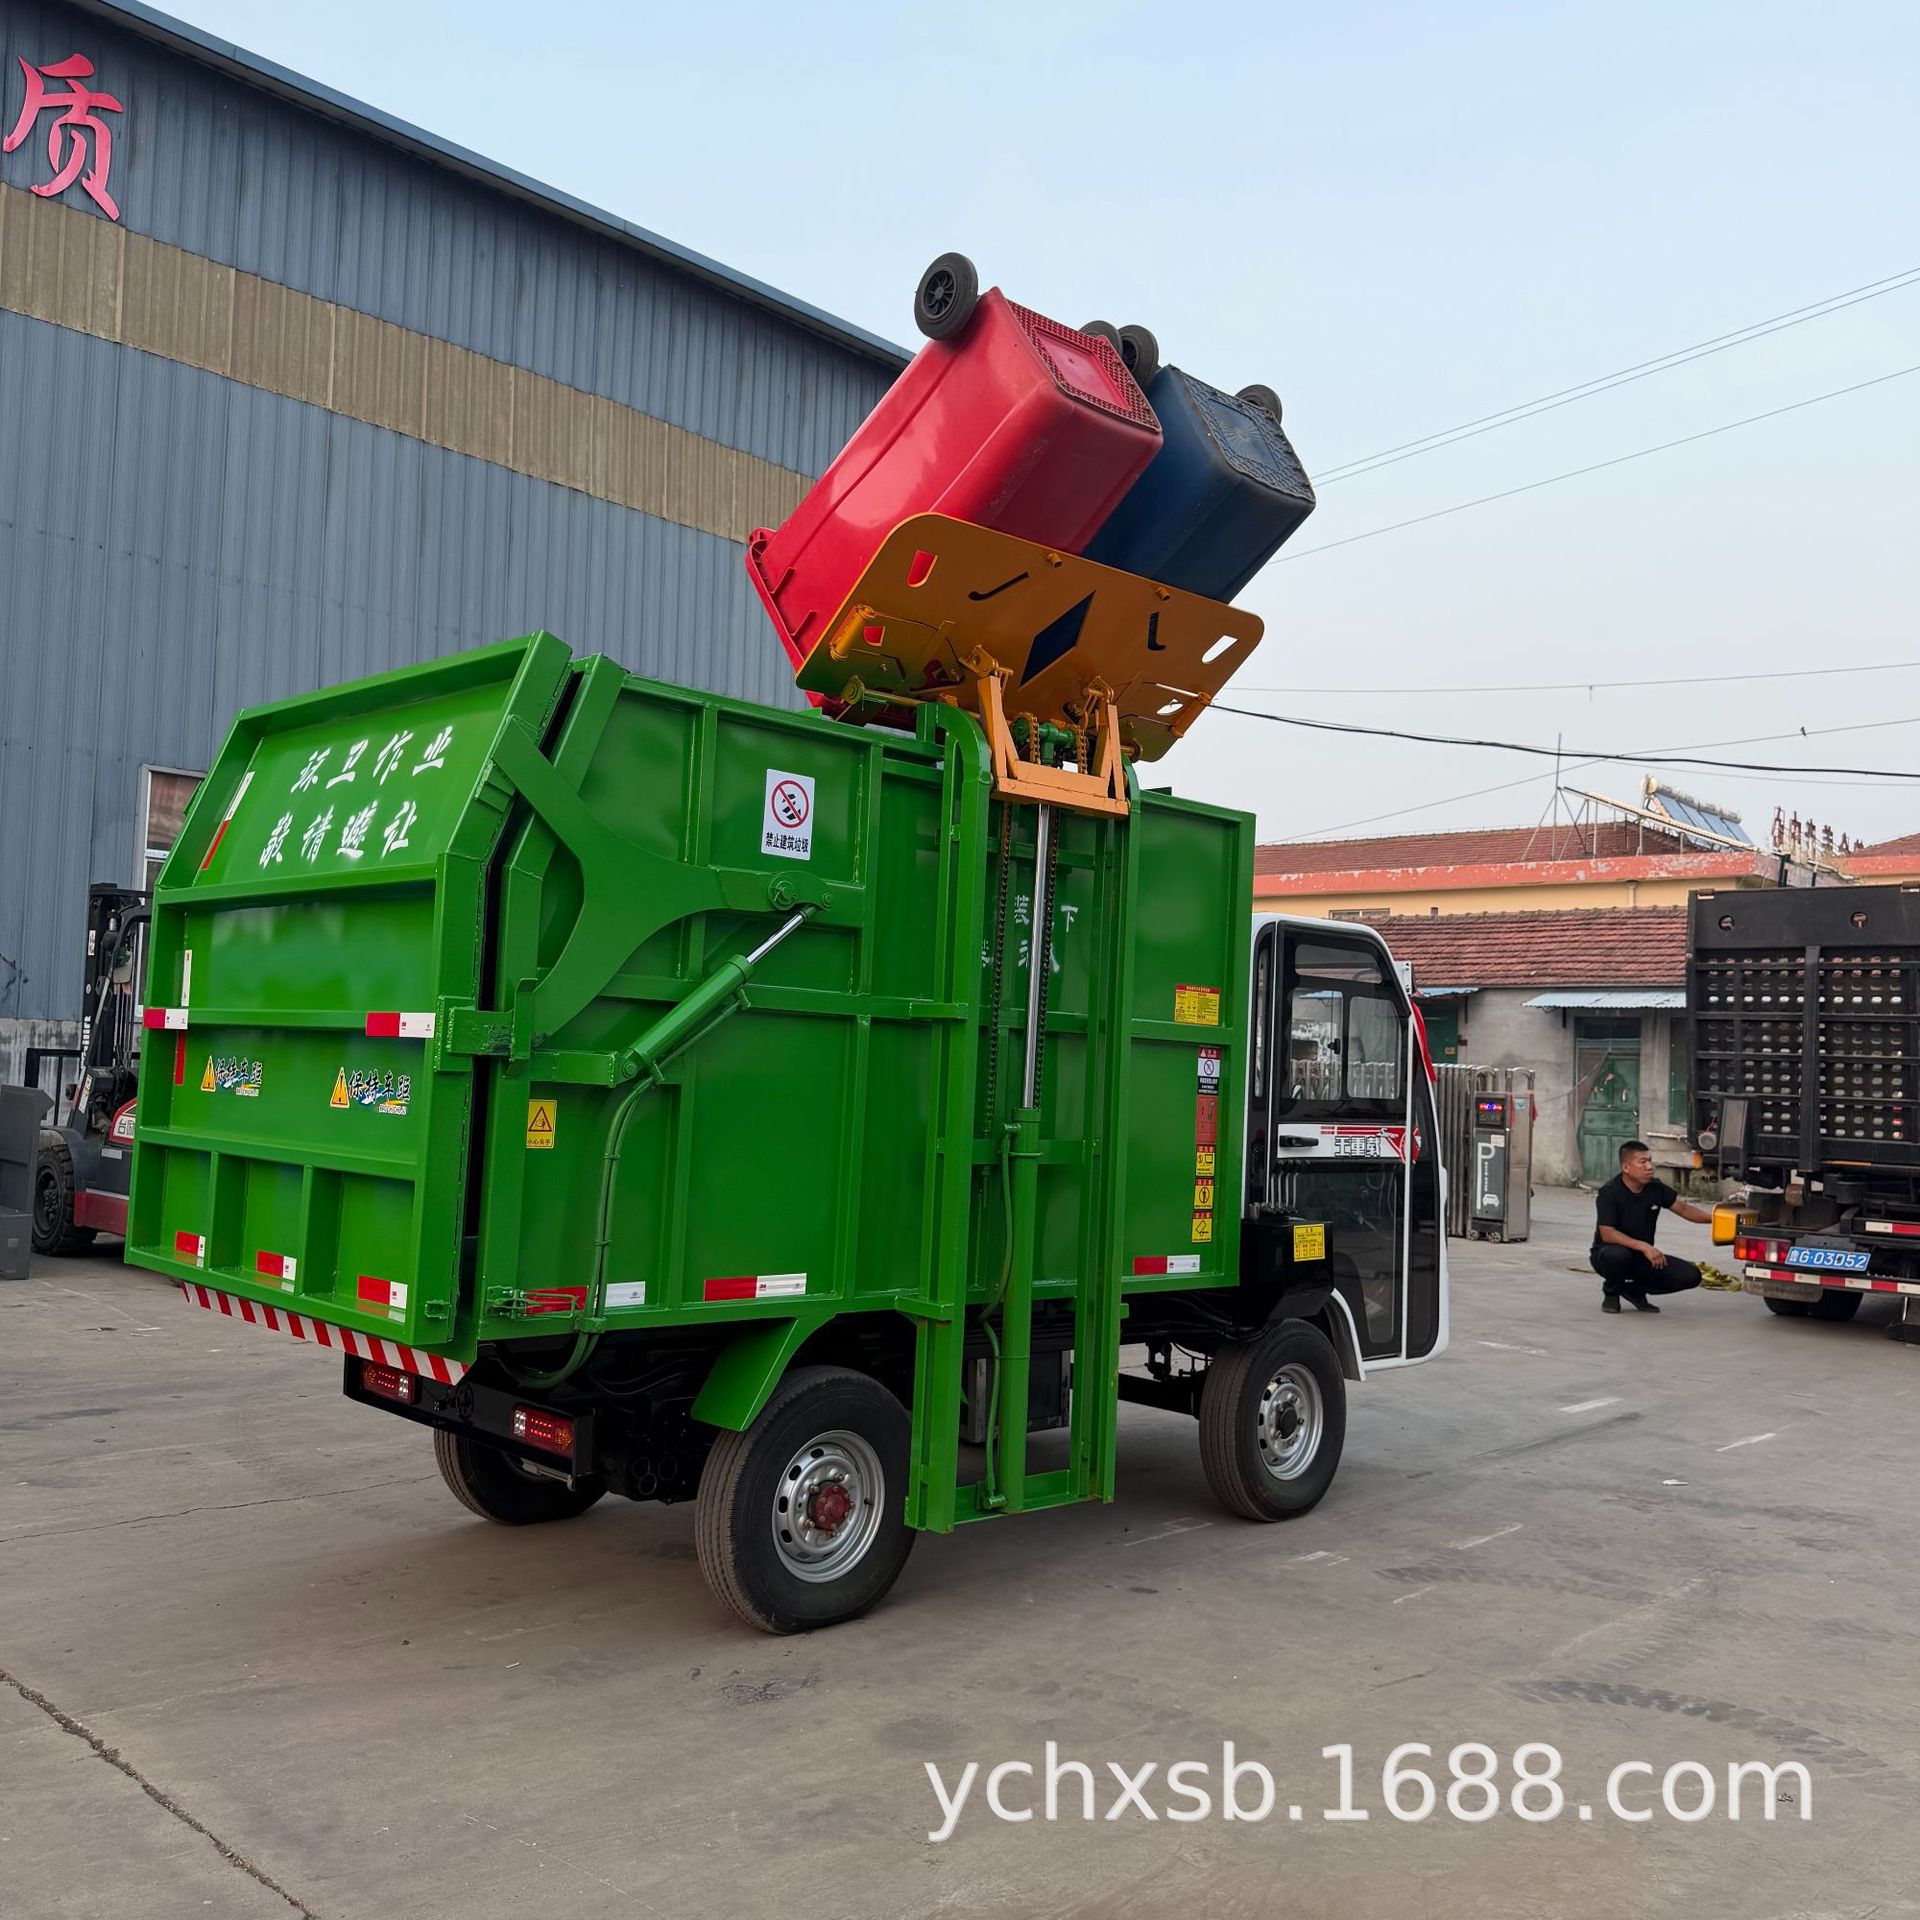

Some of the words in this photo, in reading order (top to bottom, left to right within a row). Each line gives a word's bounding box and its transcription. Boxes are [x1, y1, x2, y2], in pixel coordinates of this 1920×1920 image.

[3, 53, 124, 222] 质
[765, 832, 809, 853] 禁止建筑垃圾
[349, 1069, 411, 1101] 保持车距
